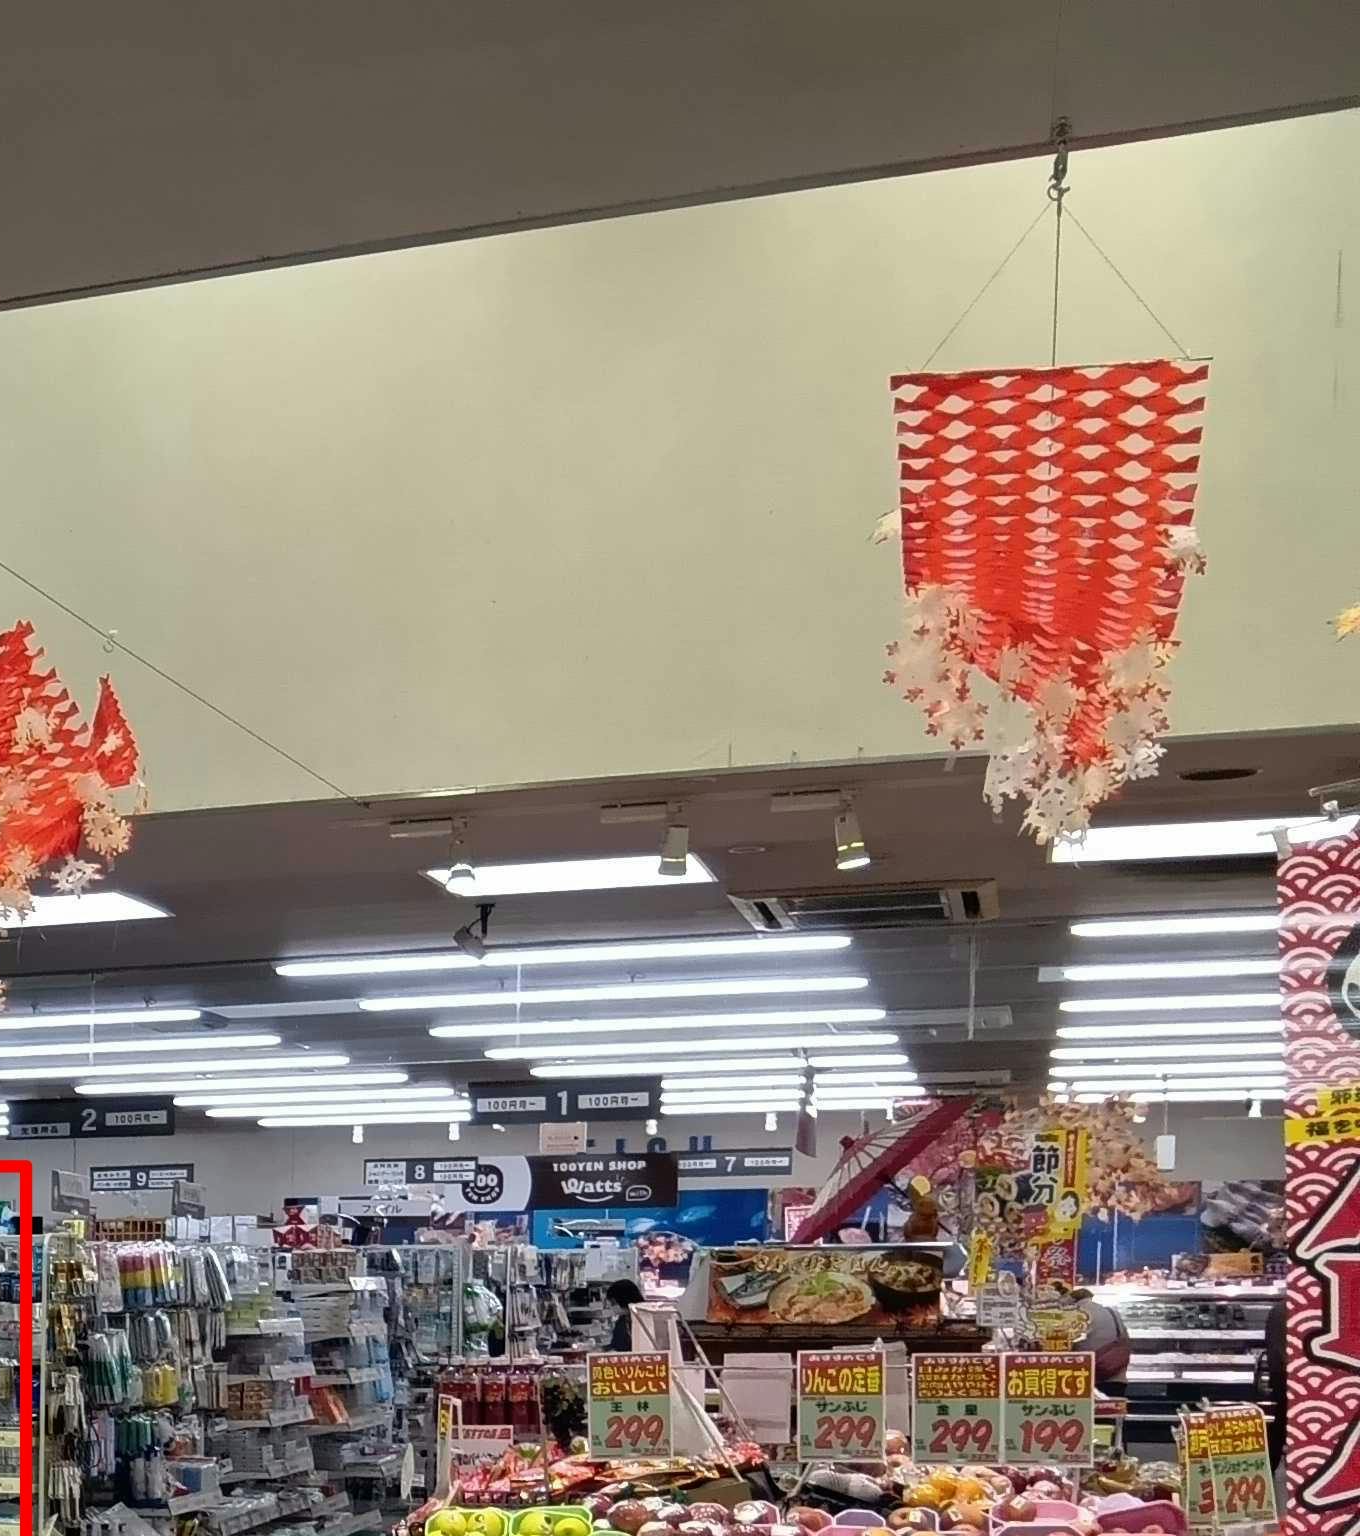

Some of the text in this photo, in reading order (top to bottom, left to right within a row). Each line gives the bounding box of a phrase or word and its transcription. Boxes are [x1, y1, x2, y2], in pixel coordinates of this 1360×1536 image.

[557, 1091, 567, 1115] 1
[82, 1108, 96, 1131] 2
[414, 1165, 425, 1181] 8
[608, 1160, 647, 1171] SHOP
[724, 1157, 736, 1172] 7
[1030, 1143, 1059, 1205] 節分
[136, 1172, 147, 1186] 9
[561, 1177, 623, 1194] Watts
[592, 1381, 666, 1395] おいしい
[802, 1367, 881, 1393] りんごの定番
[1008, 1370, 1090, 1396] お買得です
[815, 1402, 869, 1413] サンふじ
[1022, 1404, 1076, 1416] サンふじ
[606, 1416, 664, 1449] 299
[814, 1415, 876, 1449] 299
[929, 1418, 993, 1453] 299
[1021, 1419, 1085, 1453] 199
[1224, 1474, 1266, 1513] 299
